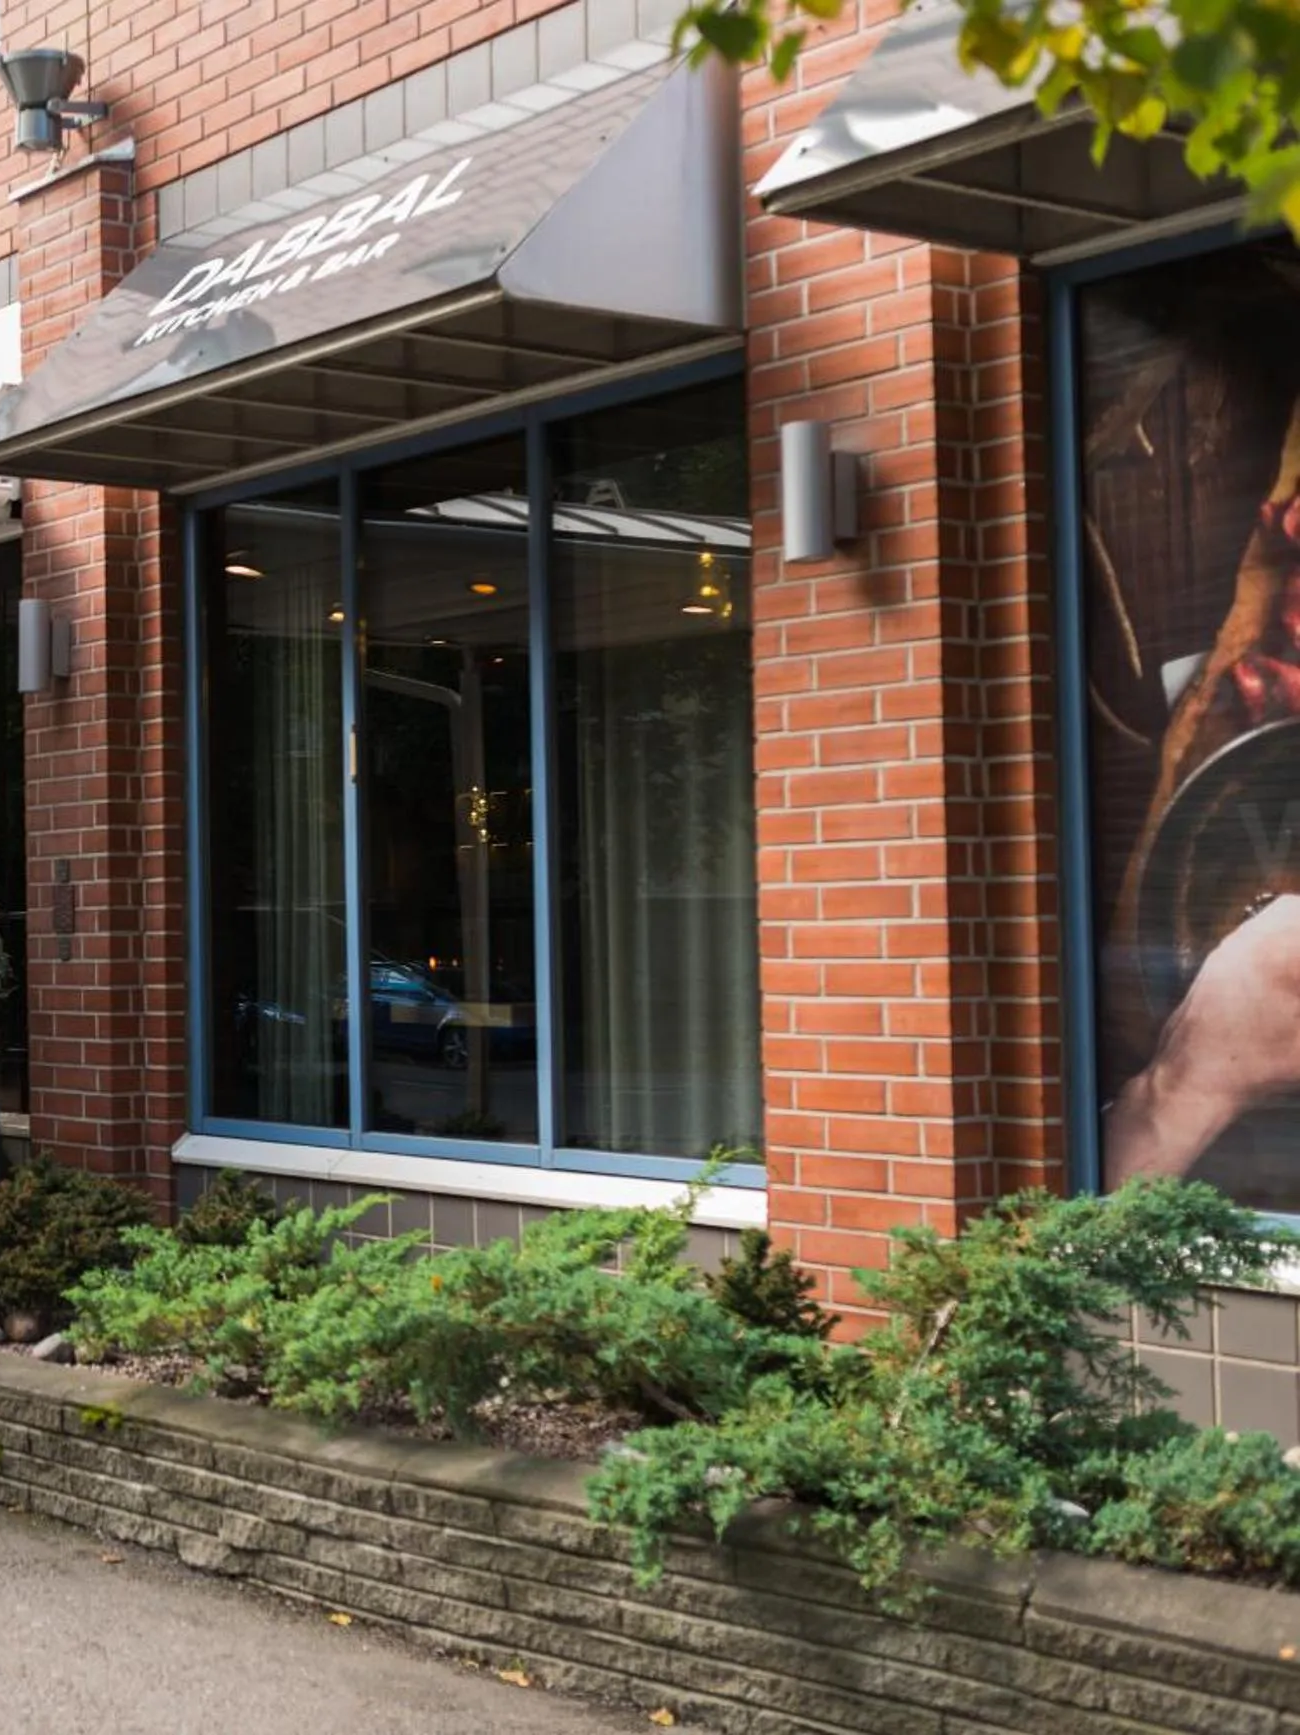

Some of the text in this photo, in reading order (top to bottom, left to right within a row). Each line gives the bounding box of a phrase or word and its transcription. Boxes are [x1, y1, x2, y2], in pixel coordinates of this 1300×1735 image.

[133, 274, 286, 348] KITCHEN
[310, 232, 401, 281] BAR
[147, 156, 473, 318] DABBAL
